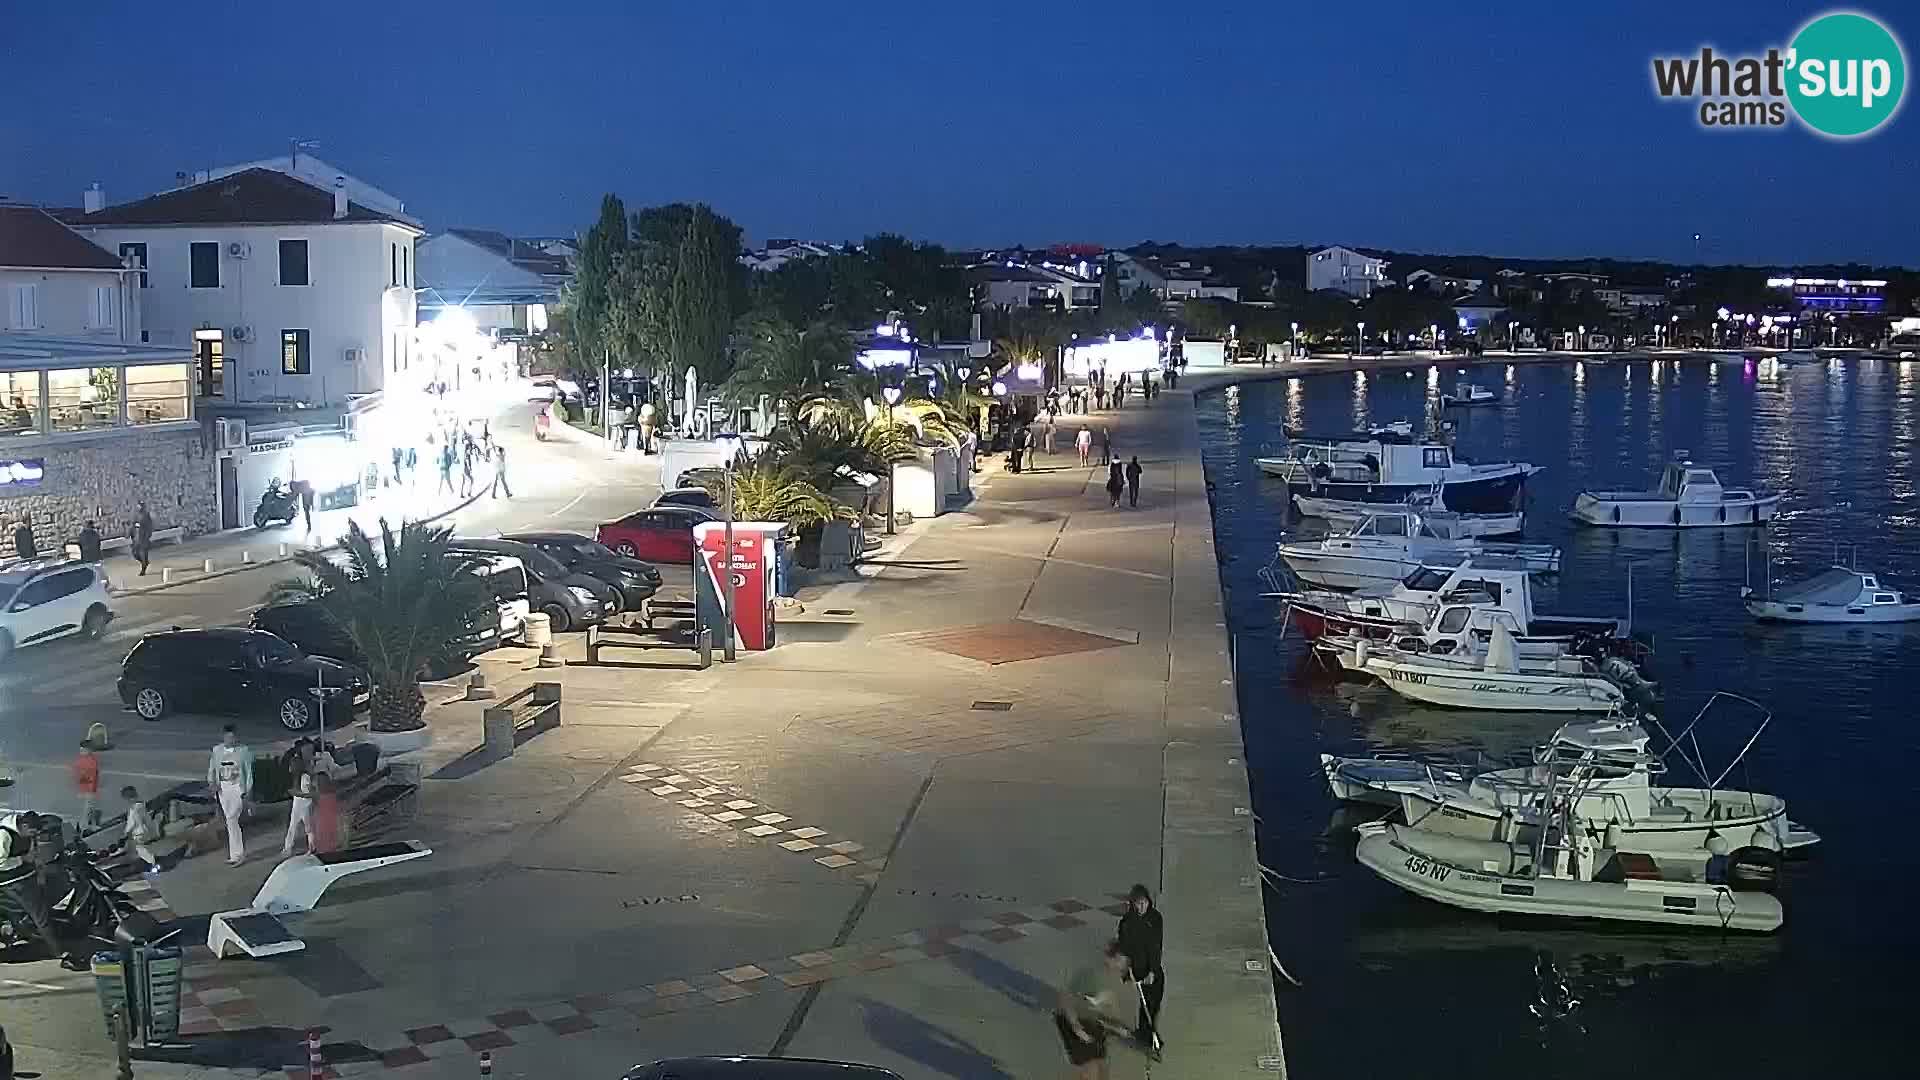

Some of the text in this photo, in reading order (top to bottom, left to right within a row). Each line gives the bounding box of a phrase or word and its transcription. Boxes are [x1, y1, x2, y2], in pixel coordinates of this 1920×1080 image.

[717, 562, 757, 570] BAKOMAT
[1404, 855, 1429, 875] 456
[1429, 863, 1451, 882] NV
